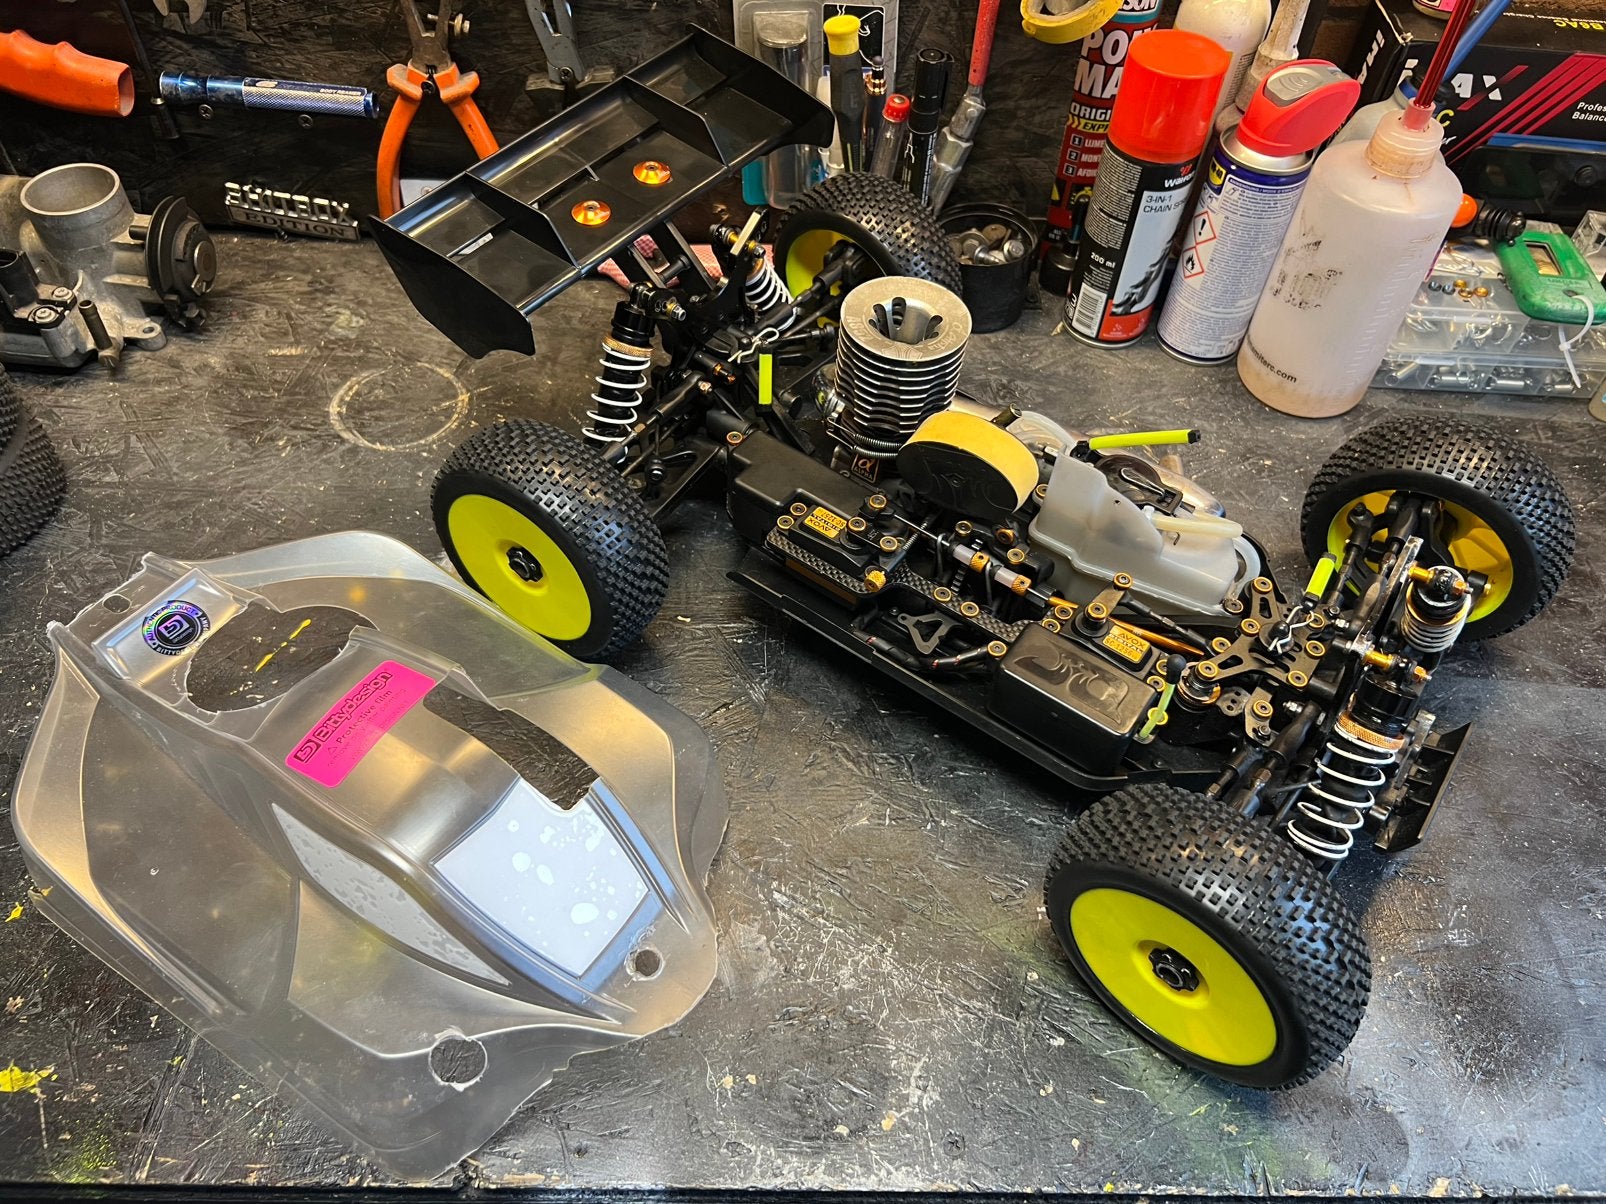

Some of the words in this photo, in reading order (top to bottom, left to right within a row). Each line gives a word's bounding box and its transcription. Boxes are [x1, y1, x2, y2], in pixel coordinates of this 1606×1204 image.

[1073, 137, 1079, 145] 1
[1067, 166, 1073, 174] 3
[1146, 195, 1173, 203] 3-IN-1
[1143, 204, 1173, 213] CHAIN
[244, 213, 346, 237] EDITION
[1090, 252, 1105, 265] 200
[1105, 260, 1116, 269] ml
[312, 671, 393, 743] Bittydesign
[336, 705, 377, 744] Protective
[375, 689, 393, 705] film
